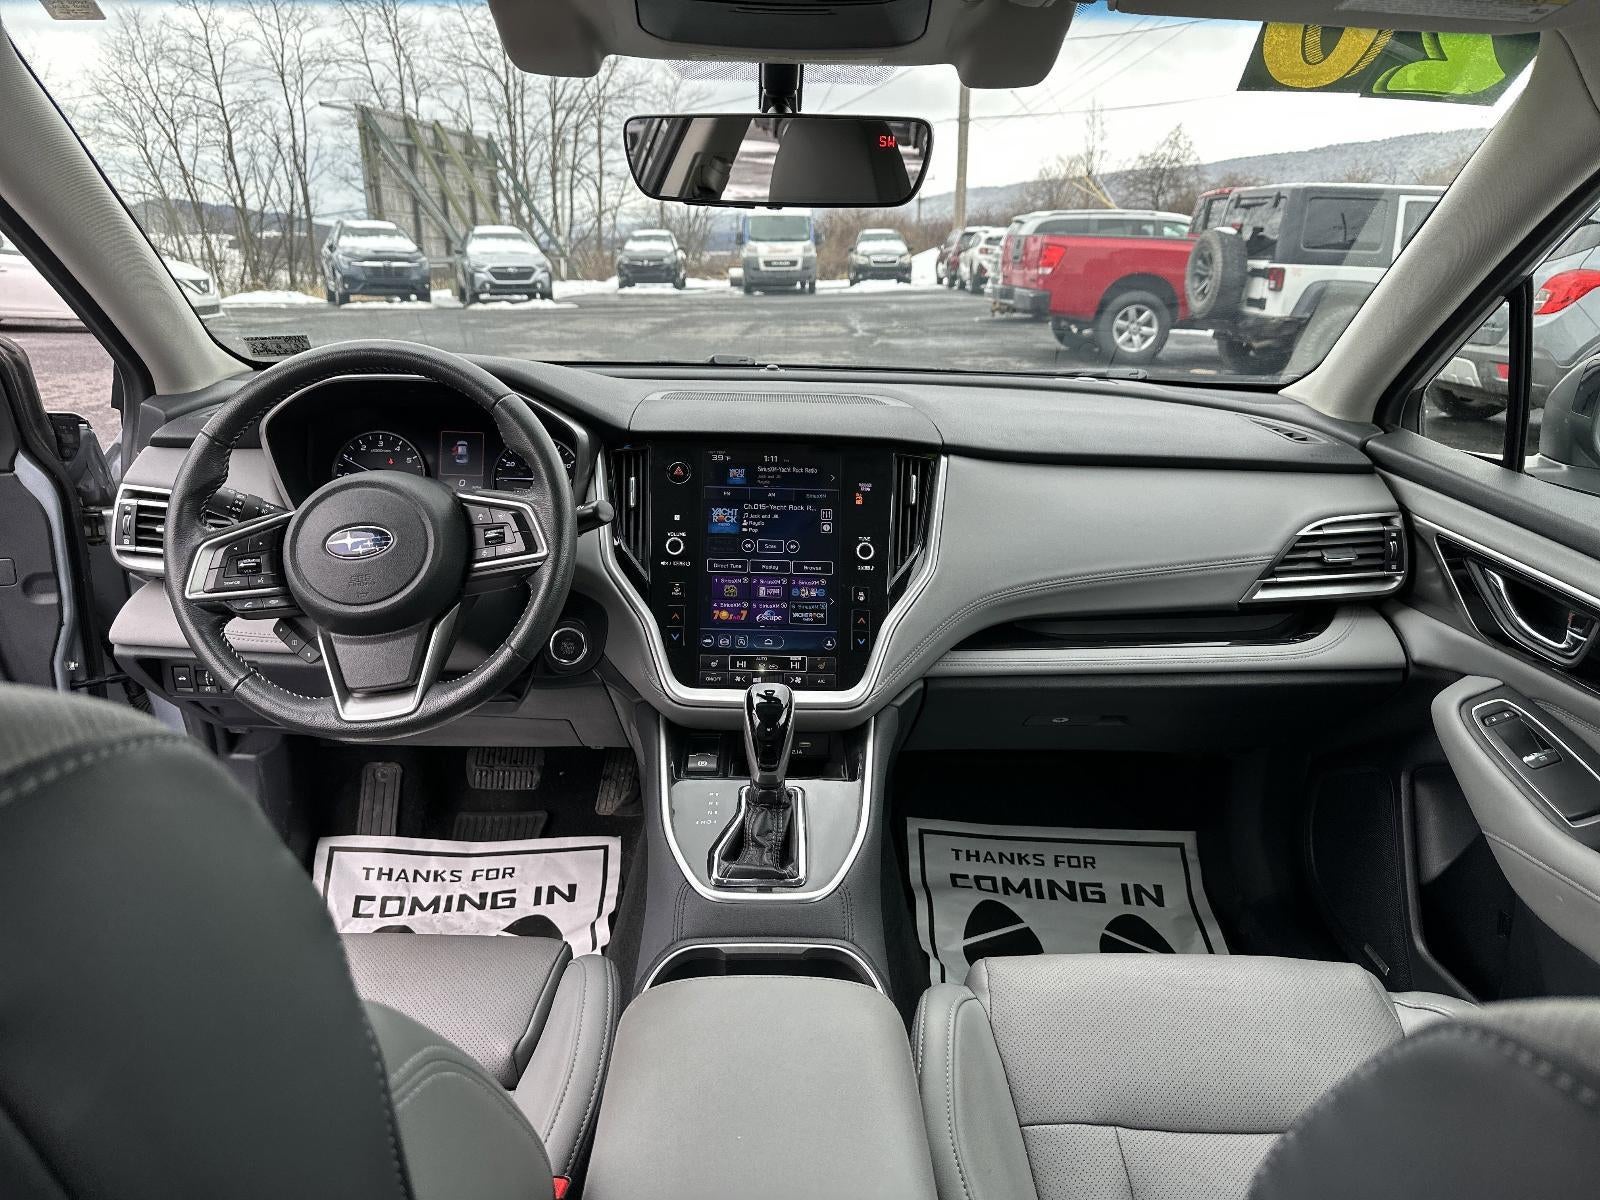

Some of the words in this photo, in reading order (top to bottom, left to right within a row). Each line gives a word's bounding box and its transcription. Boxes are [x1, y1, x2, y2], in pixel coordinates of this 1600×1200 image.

[878, 135, 896, 148] SW
[711, 507, 739, 516] YACHT
[712, 515, 738, 523] ROCK
[736, 660, 747, 668] HI
[790, 661, 801, 669] HI
[950, 848, 1045, 867] THANKS
[1054, 854, 1097, 869] FOR
[361, 866, 463, 884] THANKS
[471, 866, 516, 882] FOR
[950, 873, 1107, 904] COMING
[1120, 882, 1165, 908] IN
[351, 887, 517, 919] COMING
[532, 883, 578, 907] IN
